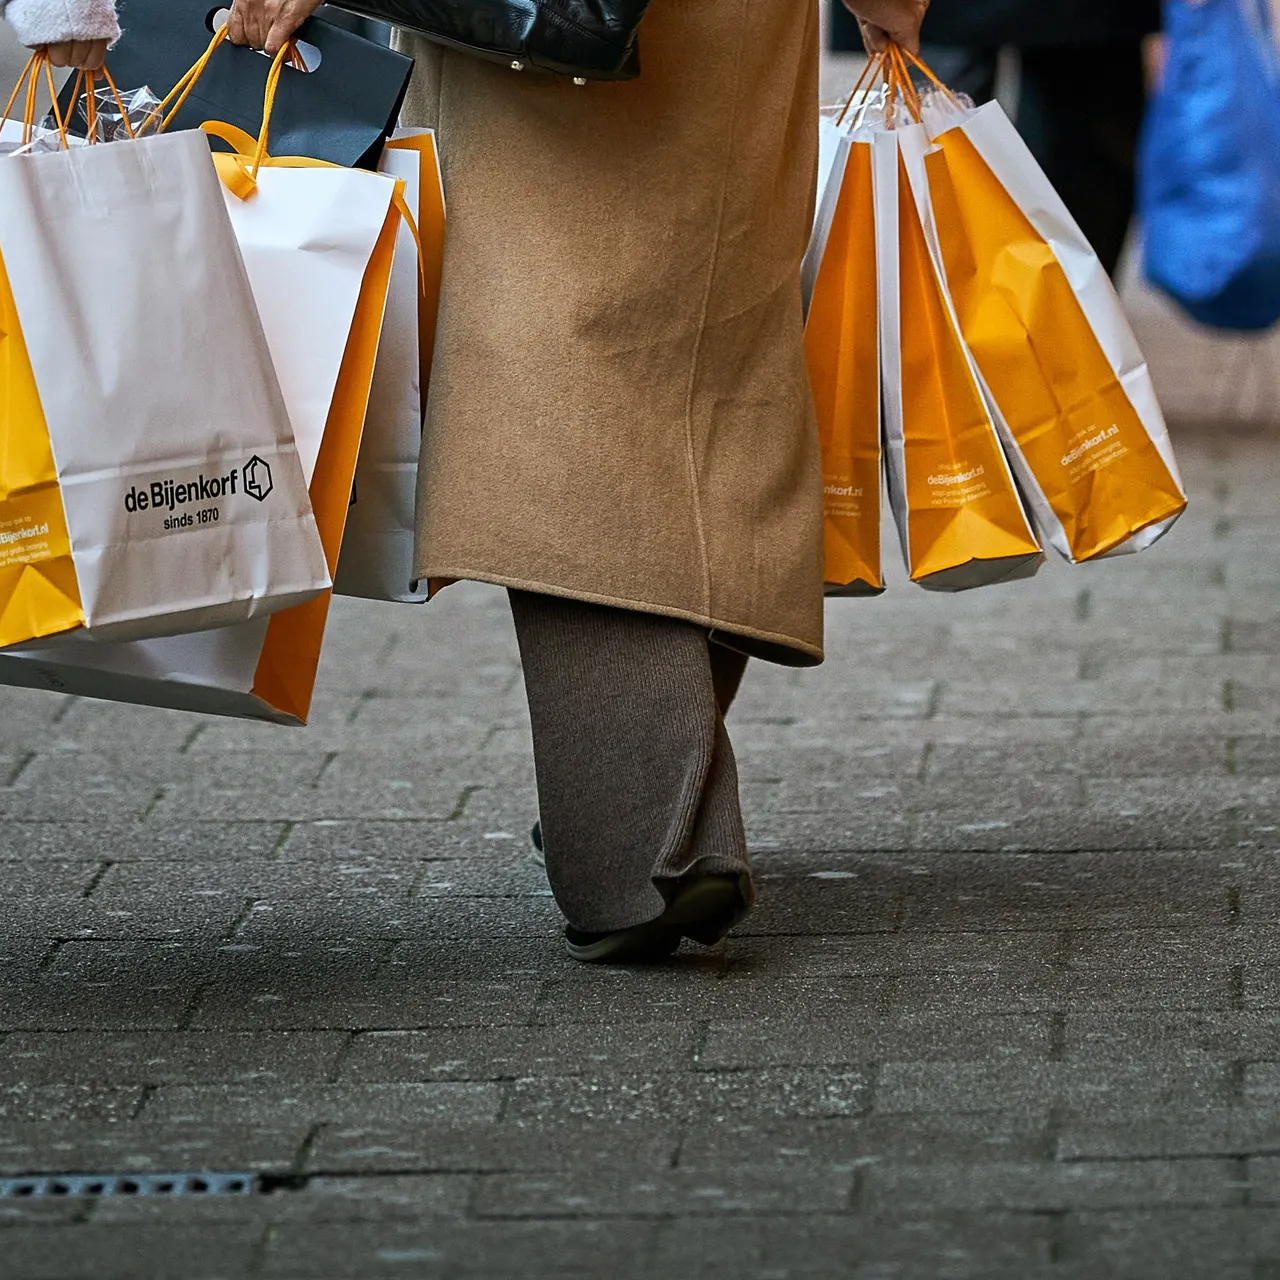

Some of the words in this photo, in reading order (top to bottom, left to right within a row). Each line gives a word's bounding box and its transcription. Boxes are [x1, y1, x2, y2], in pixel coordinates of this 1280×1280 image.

[150, 469, 238, 511] Bijenkorf
[823, 484, 863, 497] nkorf.nl
[164, 513, 193, 530] sinds
[196, 507, 219, 524] 1870
